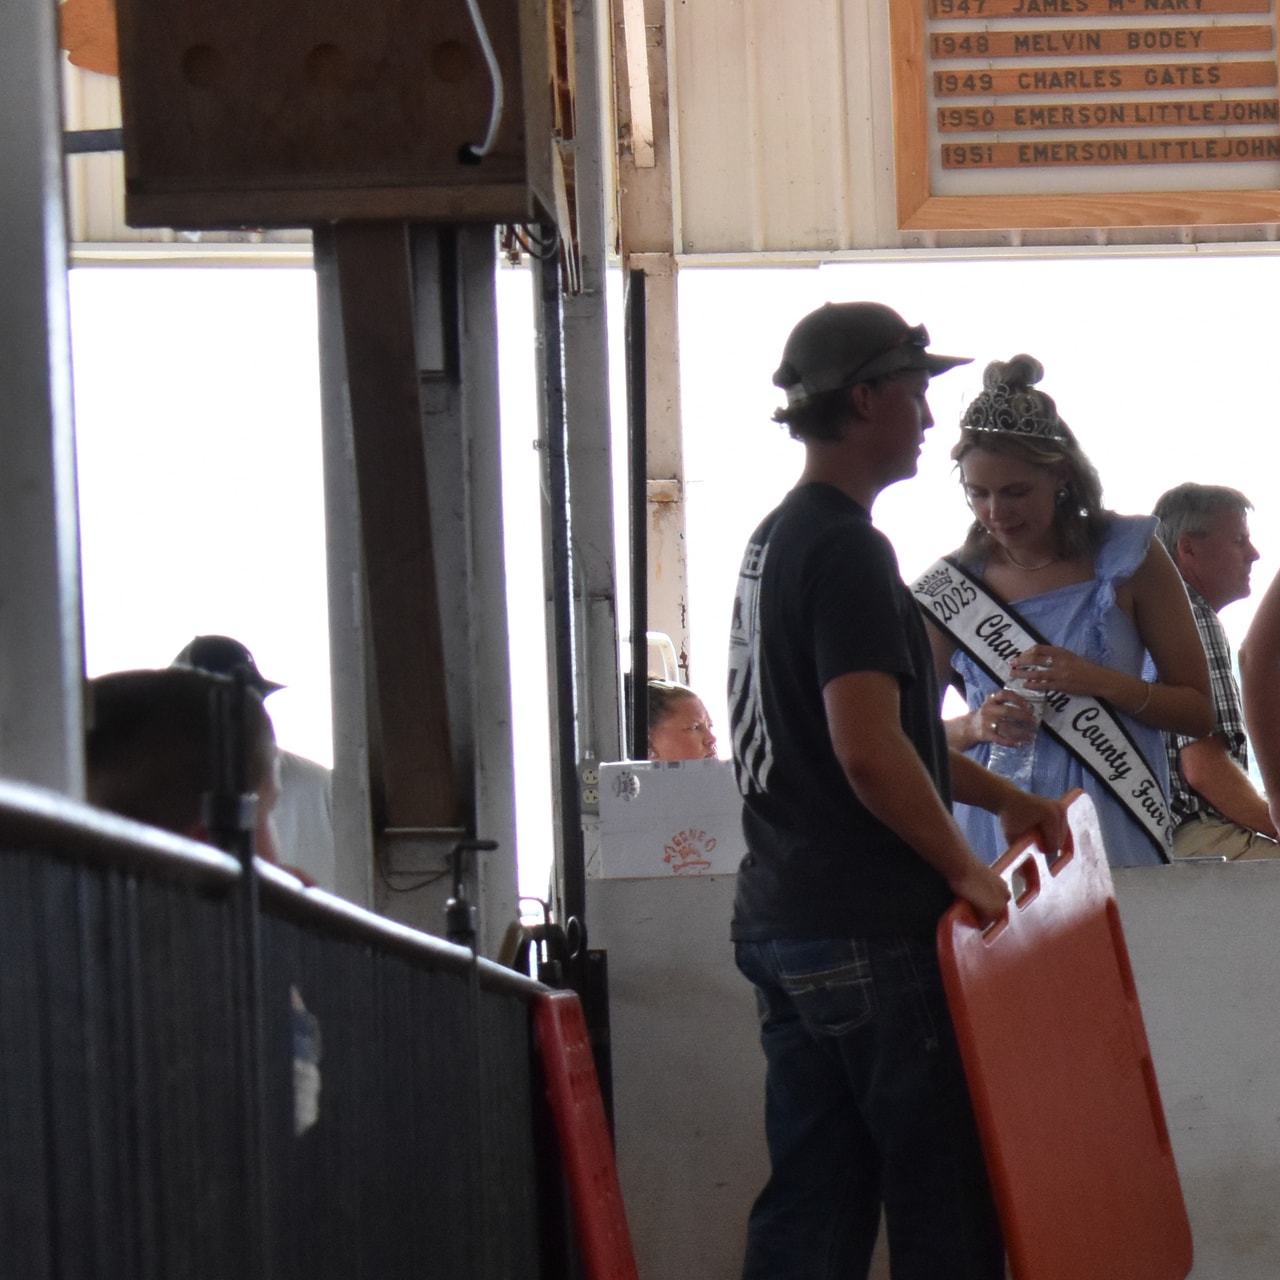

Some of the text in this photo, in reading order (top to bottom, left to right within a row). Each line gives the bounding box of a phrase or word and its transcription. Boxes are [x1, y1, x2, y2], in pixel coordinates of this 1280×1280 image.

[932, 0, 986, 13] 1947
[1013, 0, 1088, 12] JAMES
[934, 29, 1204, 54] 1948 MELVIN BODEY
[938, 66, 1221, 92] 1949 CHARLES GATES
[942, 109, 994, 127] 1950
[1015, 106, 1125, 126] EMERSON
[945, 146, 993, 164] 1951
[1019, 142, 1128, 163] EMERSON
[932, 581, 978, 625] 2025
[1071, 707, 1132, 781] County
[1131, 779, 1166, 827] Fair
